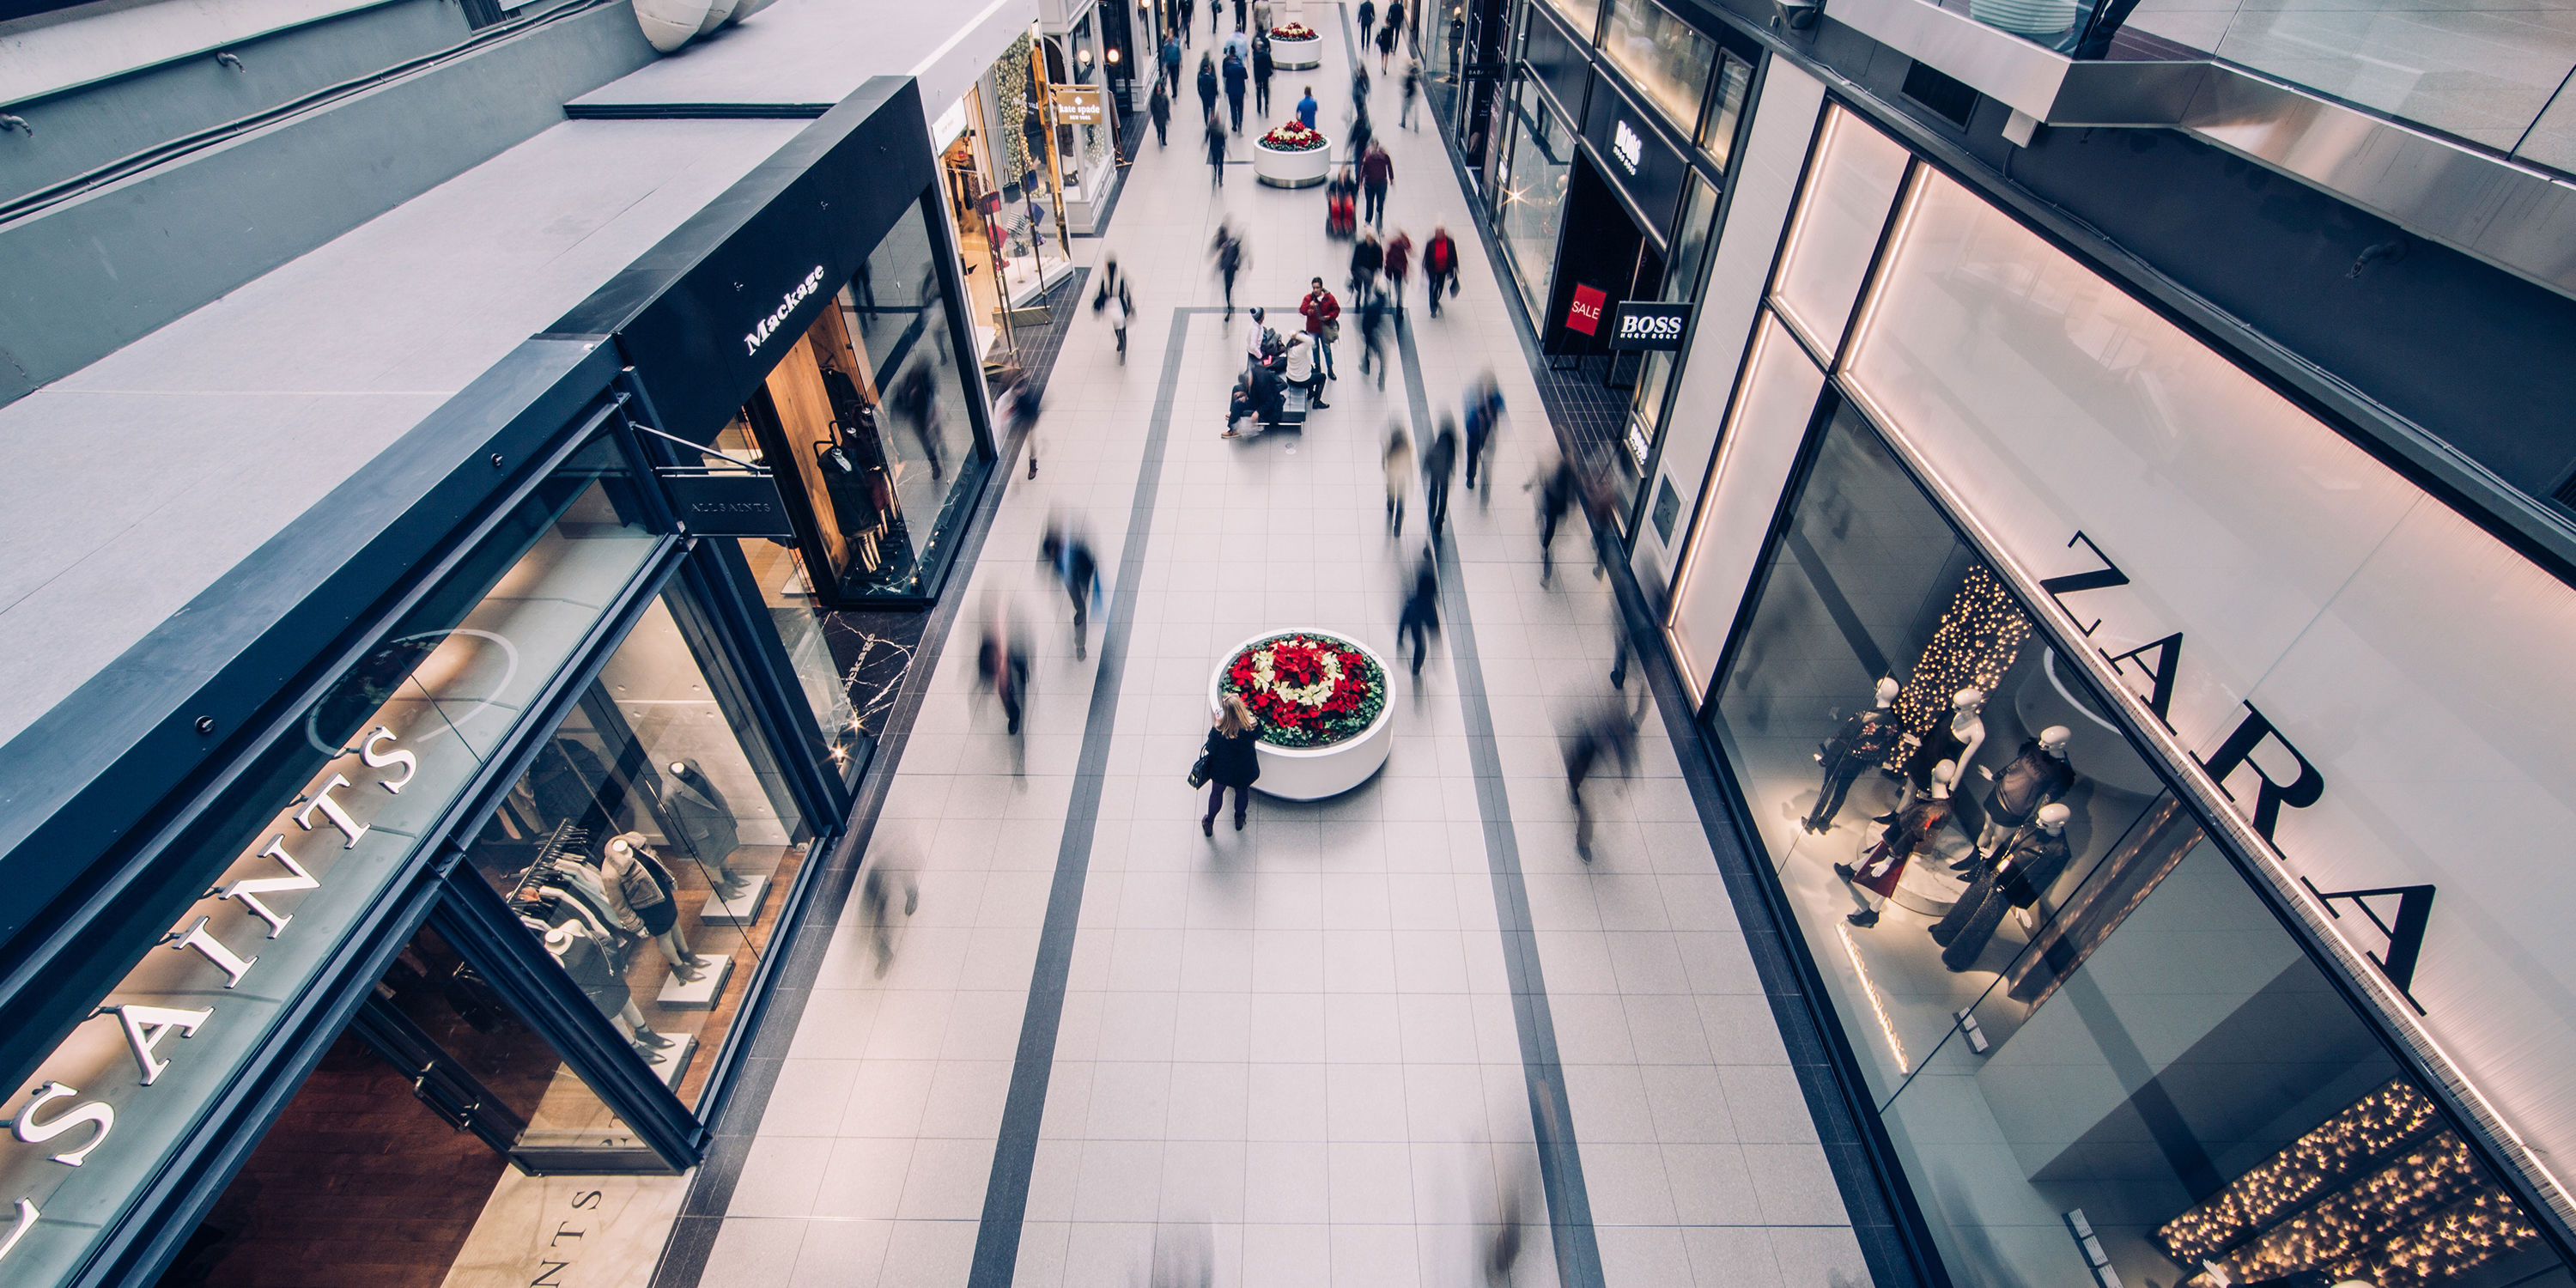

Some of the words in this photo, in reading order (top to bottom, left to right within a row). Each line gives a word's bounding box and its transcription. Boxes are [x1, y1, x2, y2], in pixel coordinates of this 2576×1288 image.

[1059, 104, 1076, 112] kate
[1077, 104, 1100, 115] spade
[744, 264, 824, 356] Mackage
[1571, 301, 1601, 319] SALE
[1620, 315, 1682, 333] BOSS
[691, 503, 771, 513] ALLSAINTS
[2039, 530, 2437, 1017] ZARA
[0, 726, 418, 1261] SAINTS
